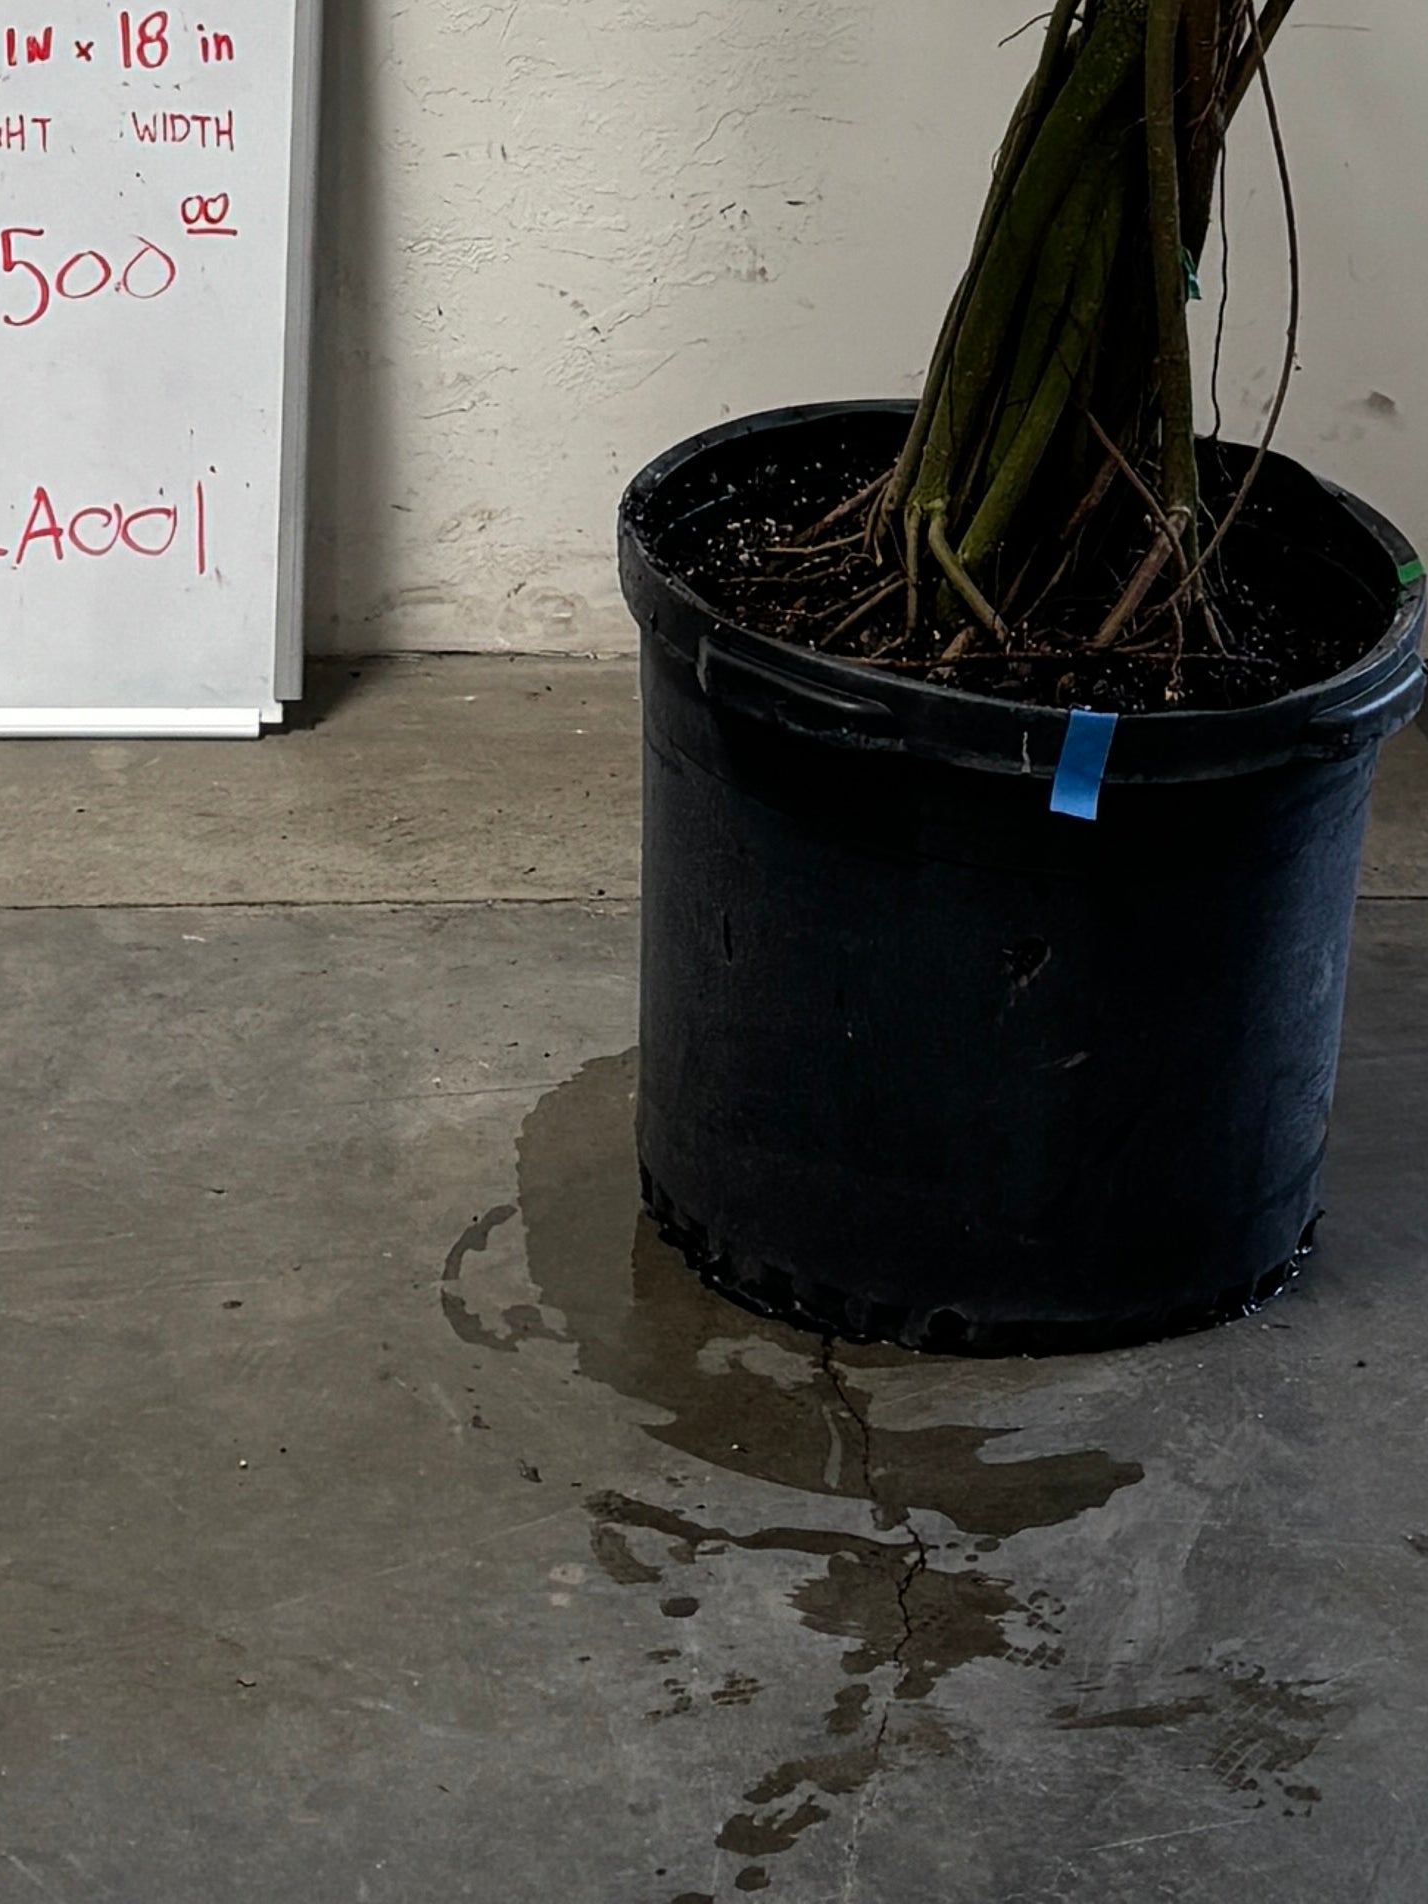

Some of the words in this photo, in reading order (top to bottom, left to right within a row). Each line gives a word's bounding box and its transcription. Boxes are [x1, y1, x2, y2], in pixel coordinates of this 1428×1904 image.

[4, 26, 53, 68] IN
[119, 10, 170, 70] 18
[196, 23, 235, 63] in
[131, 110, 235, 152] WIDTH
